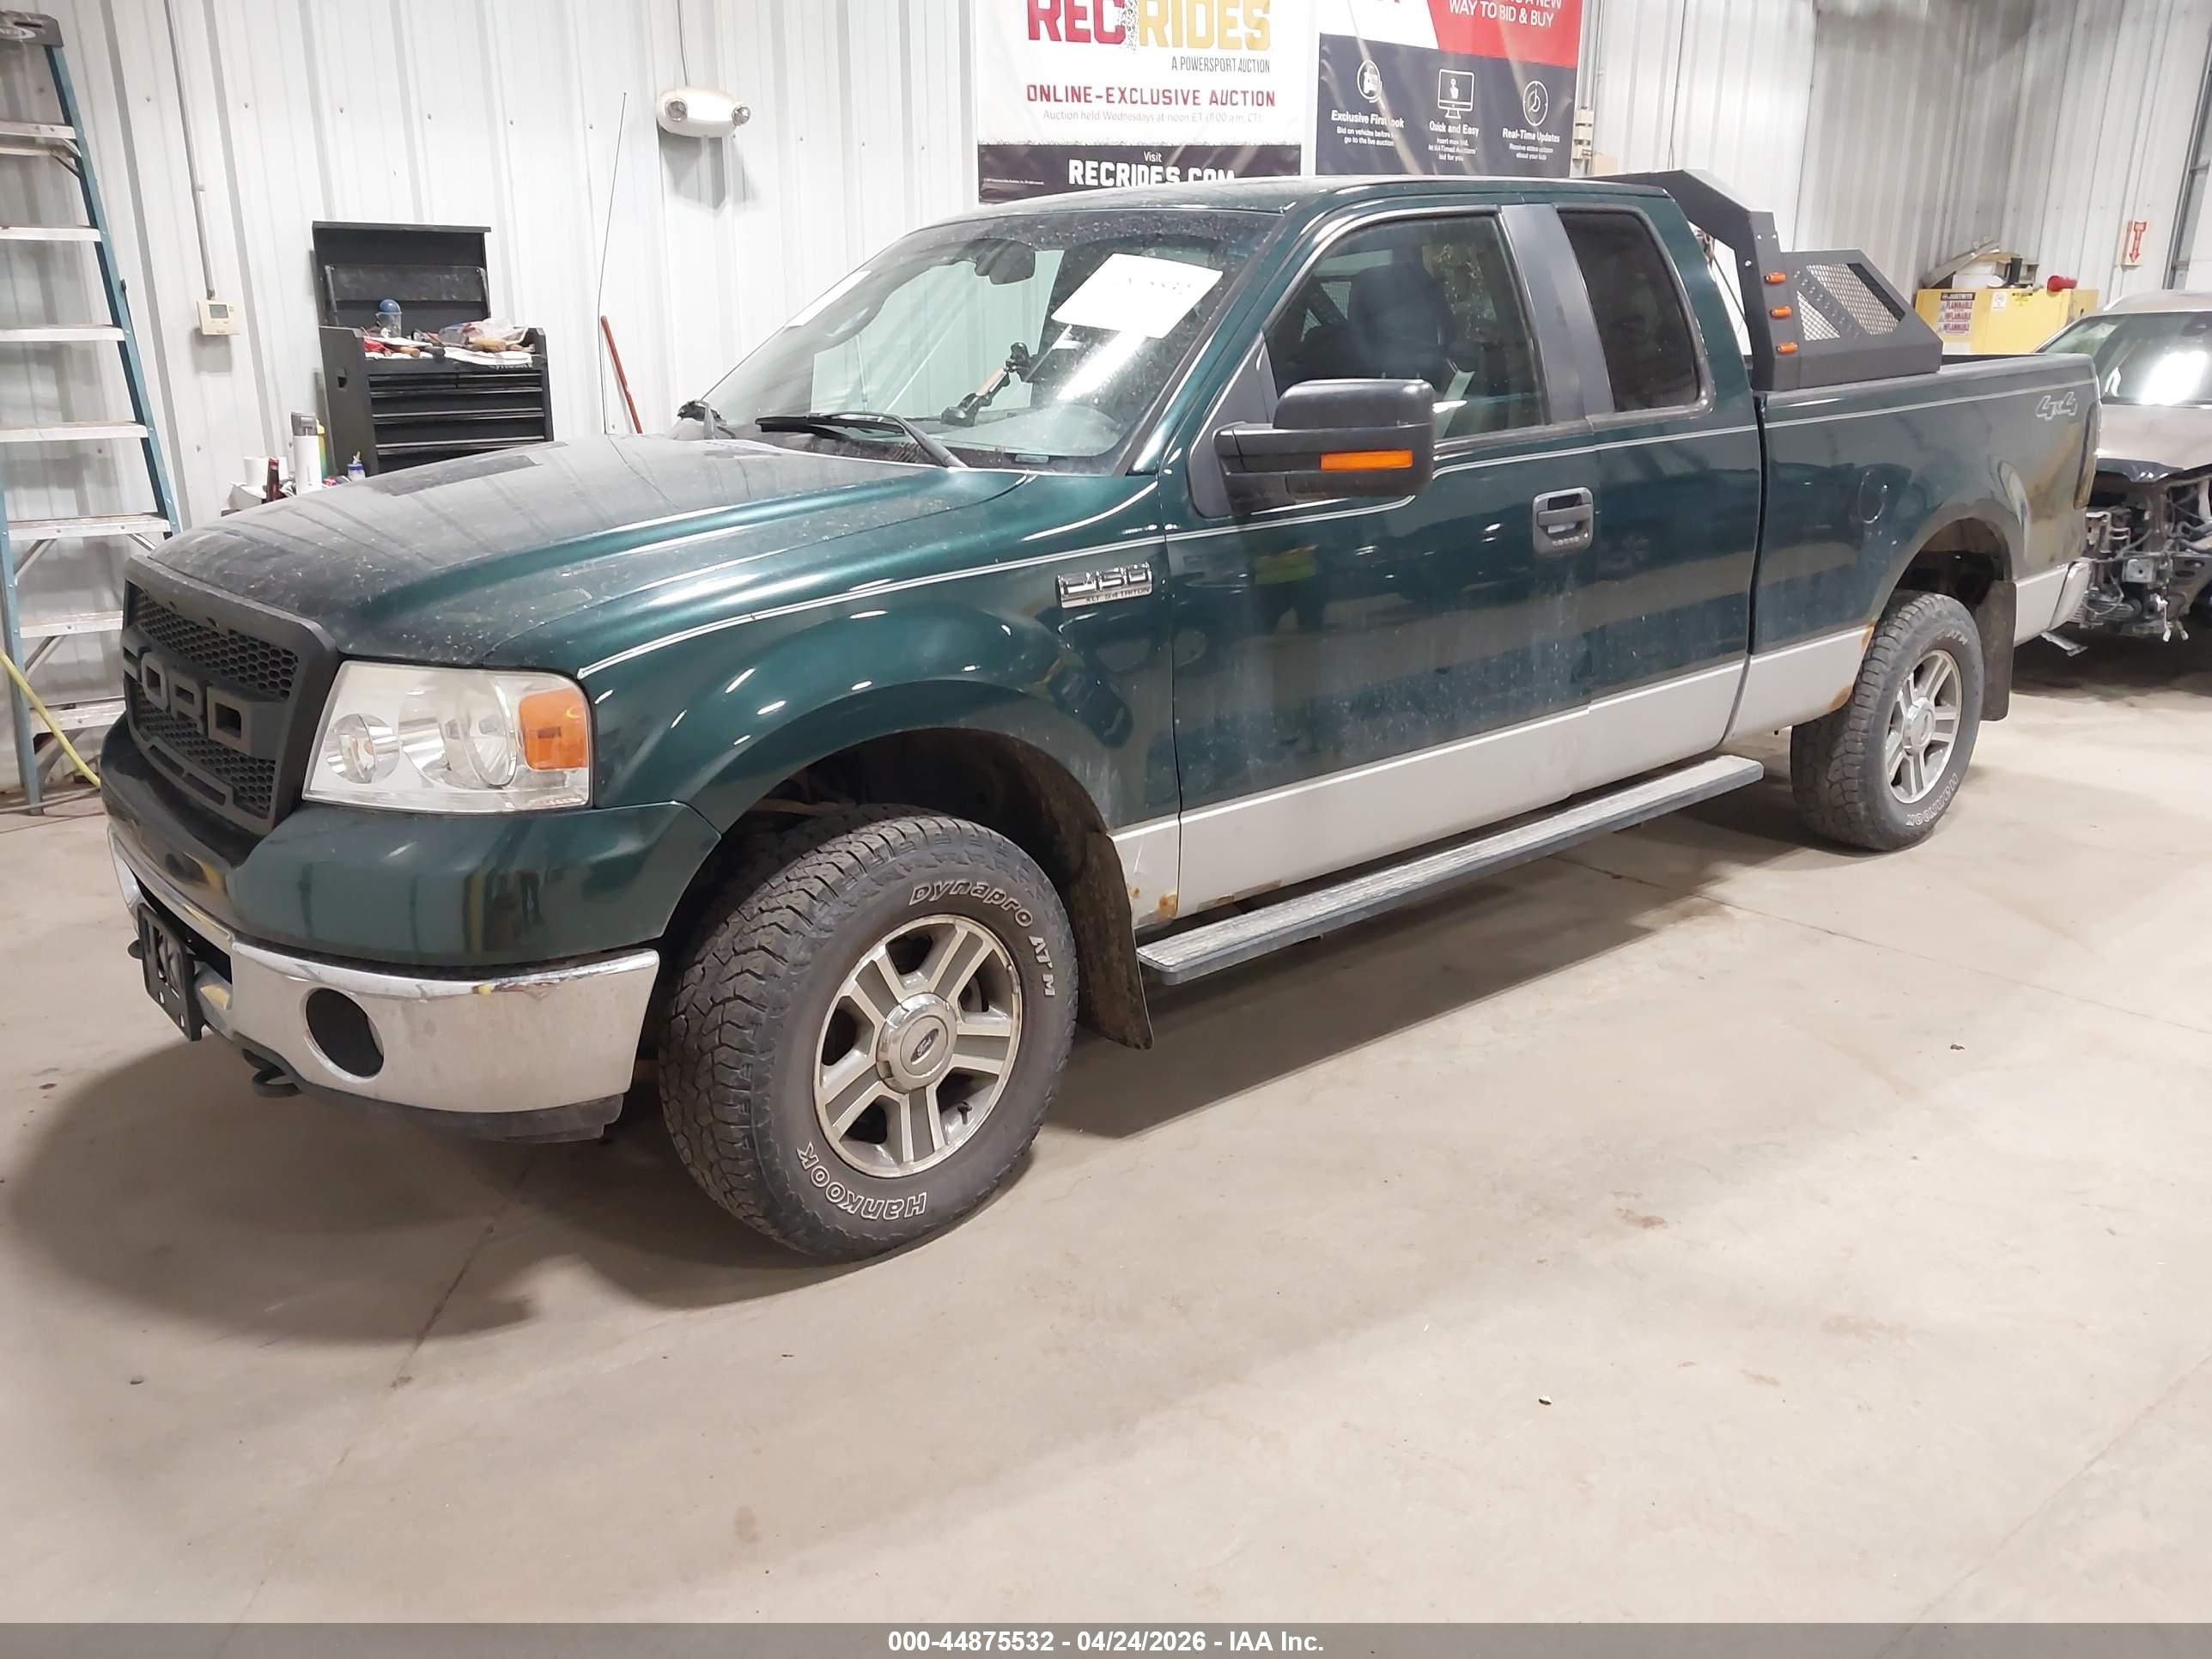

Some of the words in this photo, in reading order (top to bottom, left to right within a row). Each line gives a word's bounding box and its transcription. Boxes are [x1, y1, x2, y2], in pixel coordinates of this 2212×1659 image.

[1449, 0, 1477, 15] WAY
[1480, 1, 1498, 18] TO
[1498, 4, 1516, 22] BID
[1518, 7, 1528, 24] &
[1530, 9, 1554, 27] BUY
[1027, 0, 1126, 45] REC
[1138, 0, 1271, 51] RIDES
[1171, 56, 1178, 71] A
[1180, 57, 1237, 72] POWERSPORT
[1237, 58, 1271, 74] AUCTION
[1026, 83, 1201, 106] ONLINE-EXCLUSIVE
[1208, 88, 1276, 107] AUCTION
[1042, 109, 1079, 121] Auction
[1080, 111, 1101, 121] held
[1103, 112, 1155, 123] Wednesdays
[1331, 109, 1369, 124] Exclusive
[1370, 112, 1388, 126] First
[1429, 119, 1447, 133] Quick
[1448, 123, 1462, 134] and
[1462, 123, 1480, 138] Easy
[1502, 127, 1536, 141] Real-Time
[1536, 131, 1560, 143] Updates
[1143, 150, 1163, 163] Visit
[1068, 159, 1235, 187] RECRIDESCO
[2035, 392, 2078, 420] 4x4
[908, 878, 1033, 927] Dynapro
